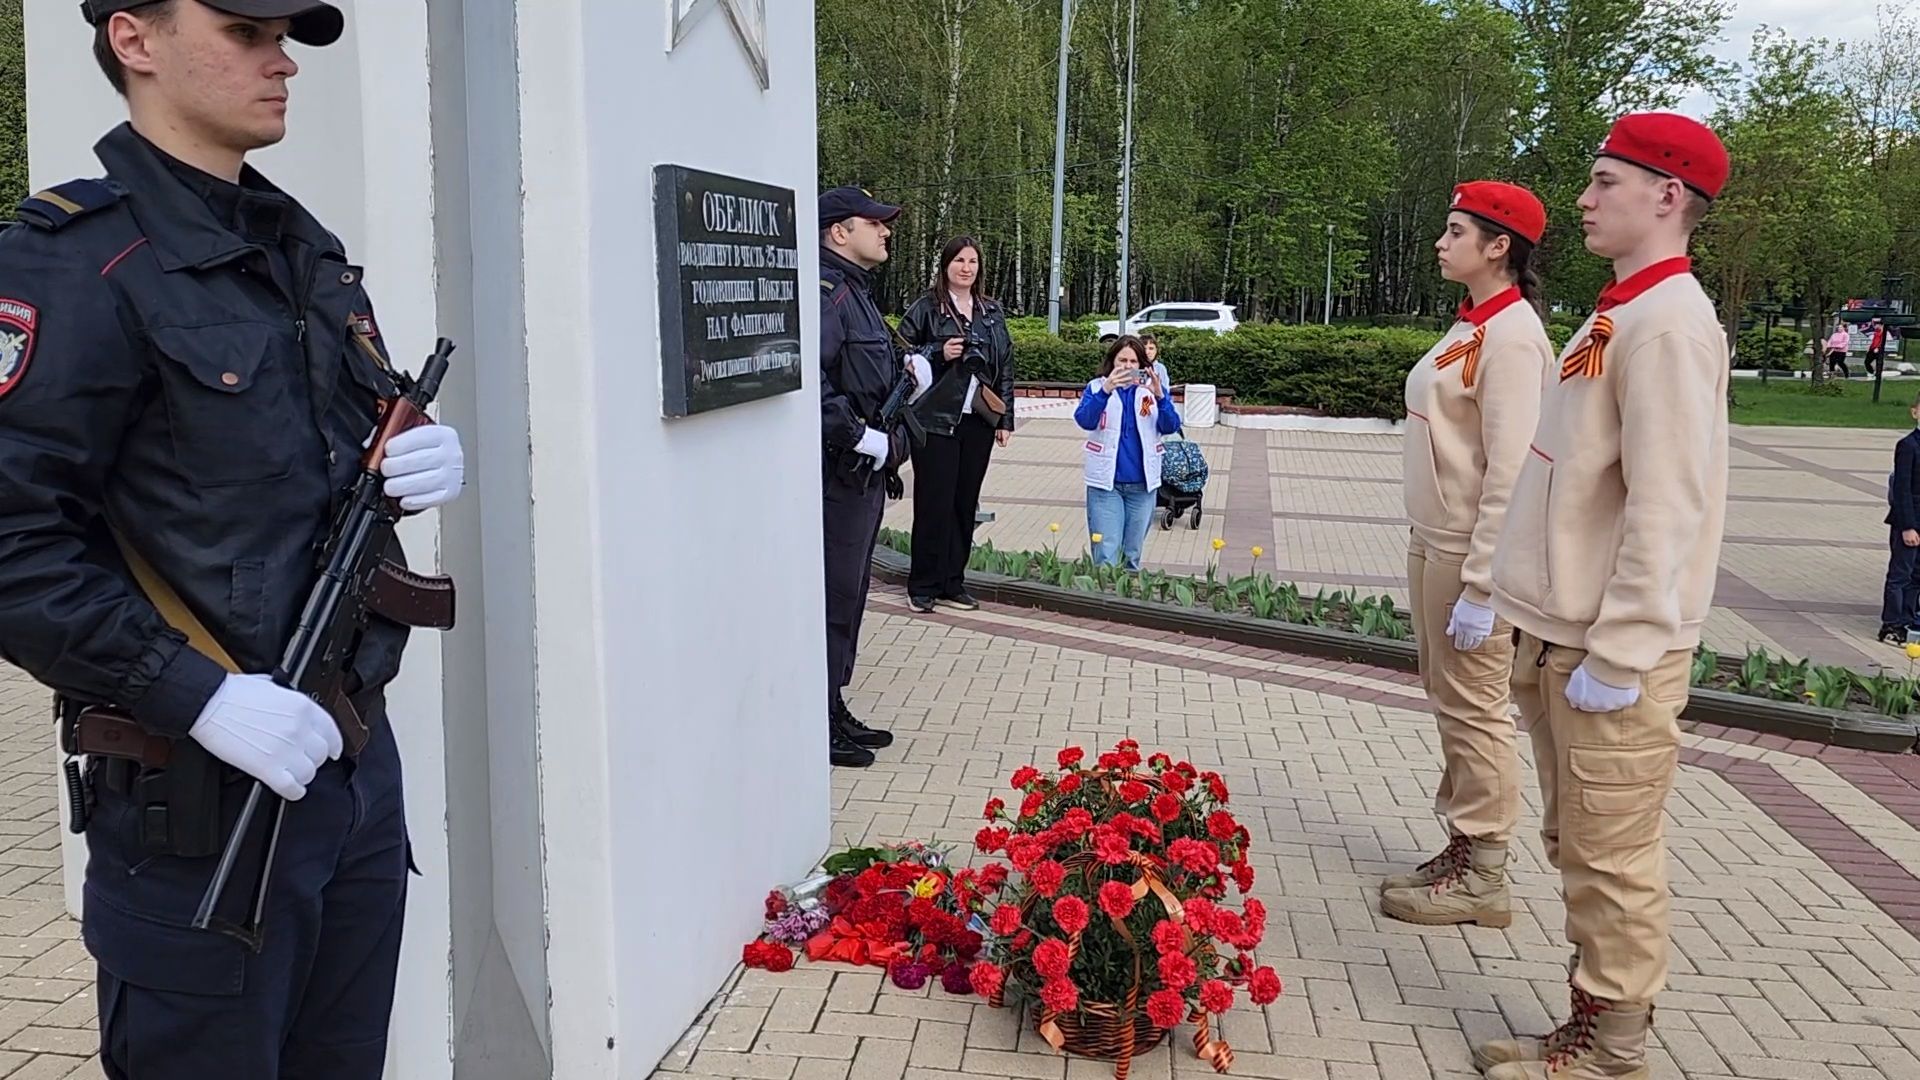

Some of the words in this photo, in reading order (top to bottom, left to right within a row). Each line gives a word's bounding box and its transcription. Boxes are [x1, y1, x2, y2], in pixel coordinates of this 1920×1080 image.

[702, 191, 780, 237] ОБЕЛИСК
[680, 242, 732, 270] ВОЗДВИГНУТ
[733, 244, 741, 267] В
[741, 245, 765, 268] ЧЕСТЬ
[765, 244, 775, 268] 25
[692, 280, 755, 309] ГОДОВЩИНЫ
[706, 316, 728, 343] НАД
[731, 312, 785, 337] ФАШИЗМОМ
